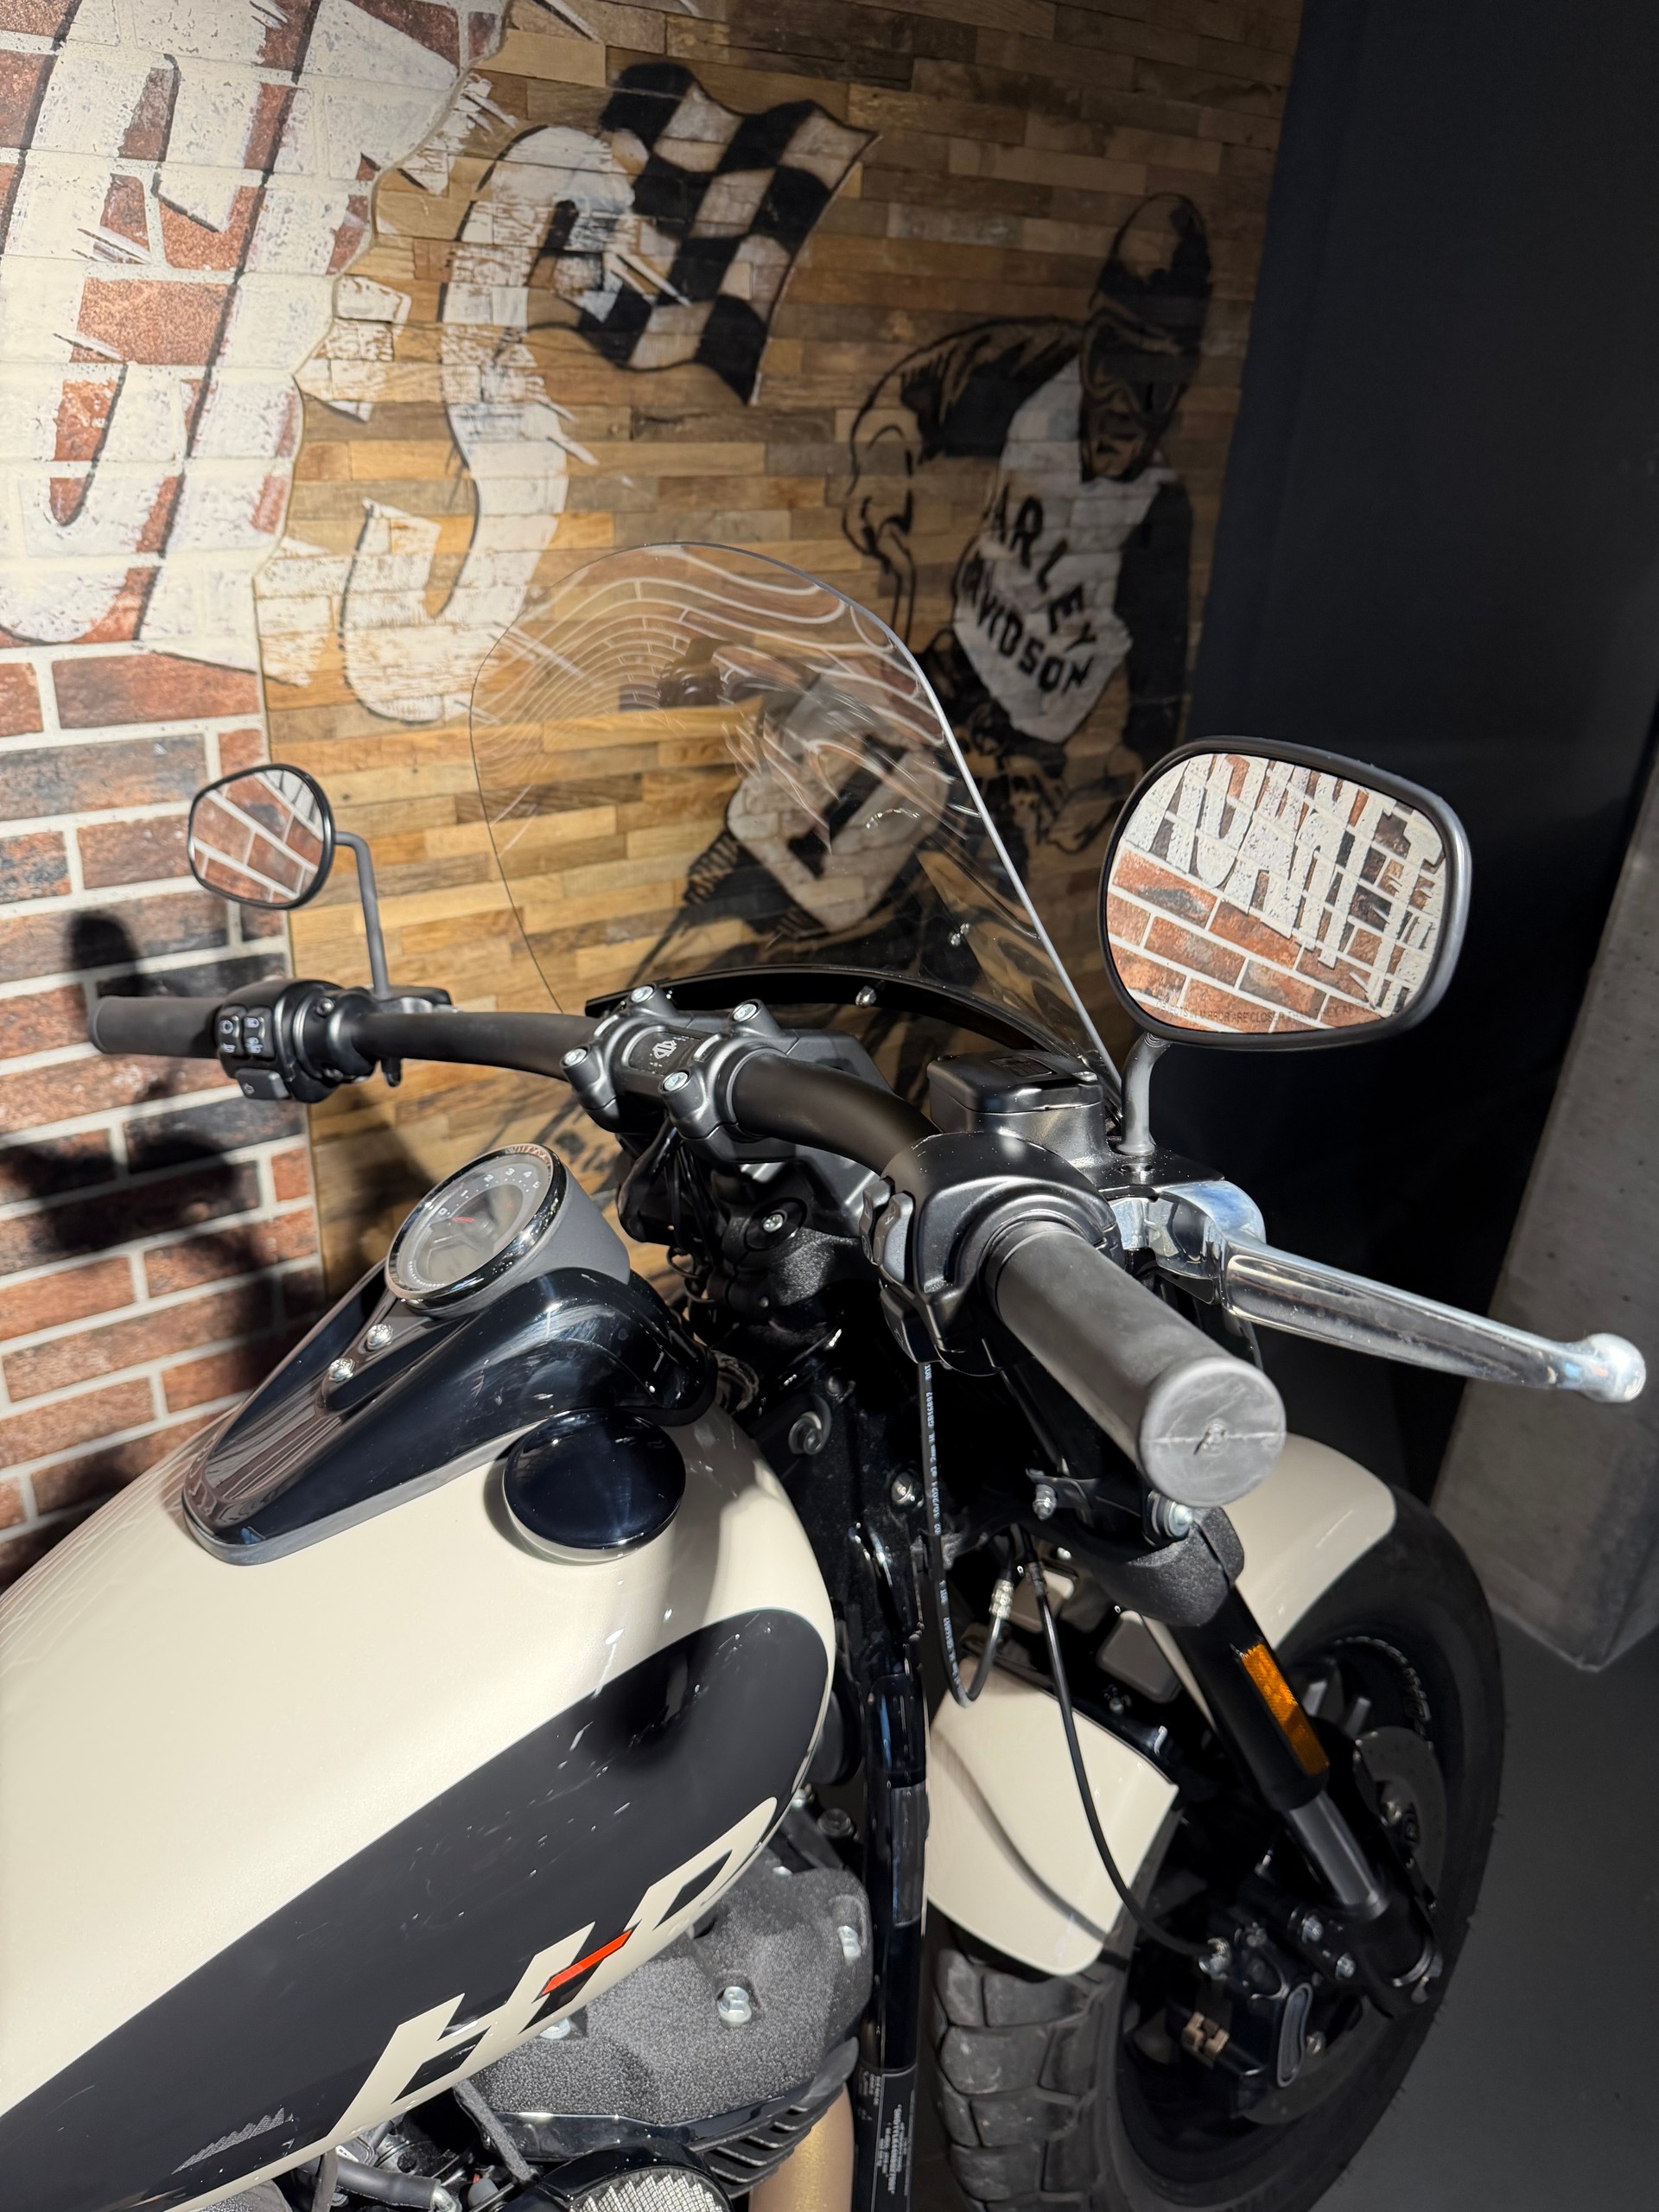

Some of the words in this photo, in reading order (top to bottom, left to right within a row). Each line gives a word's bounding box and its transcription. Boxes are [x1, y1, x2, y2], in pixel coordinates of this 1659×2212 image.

[484, 1173, 494, 1182] 2
[505, 1167, 516, 1176] 3
[523, 1170, 533, 1179] 4
